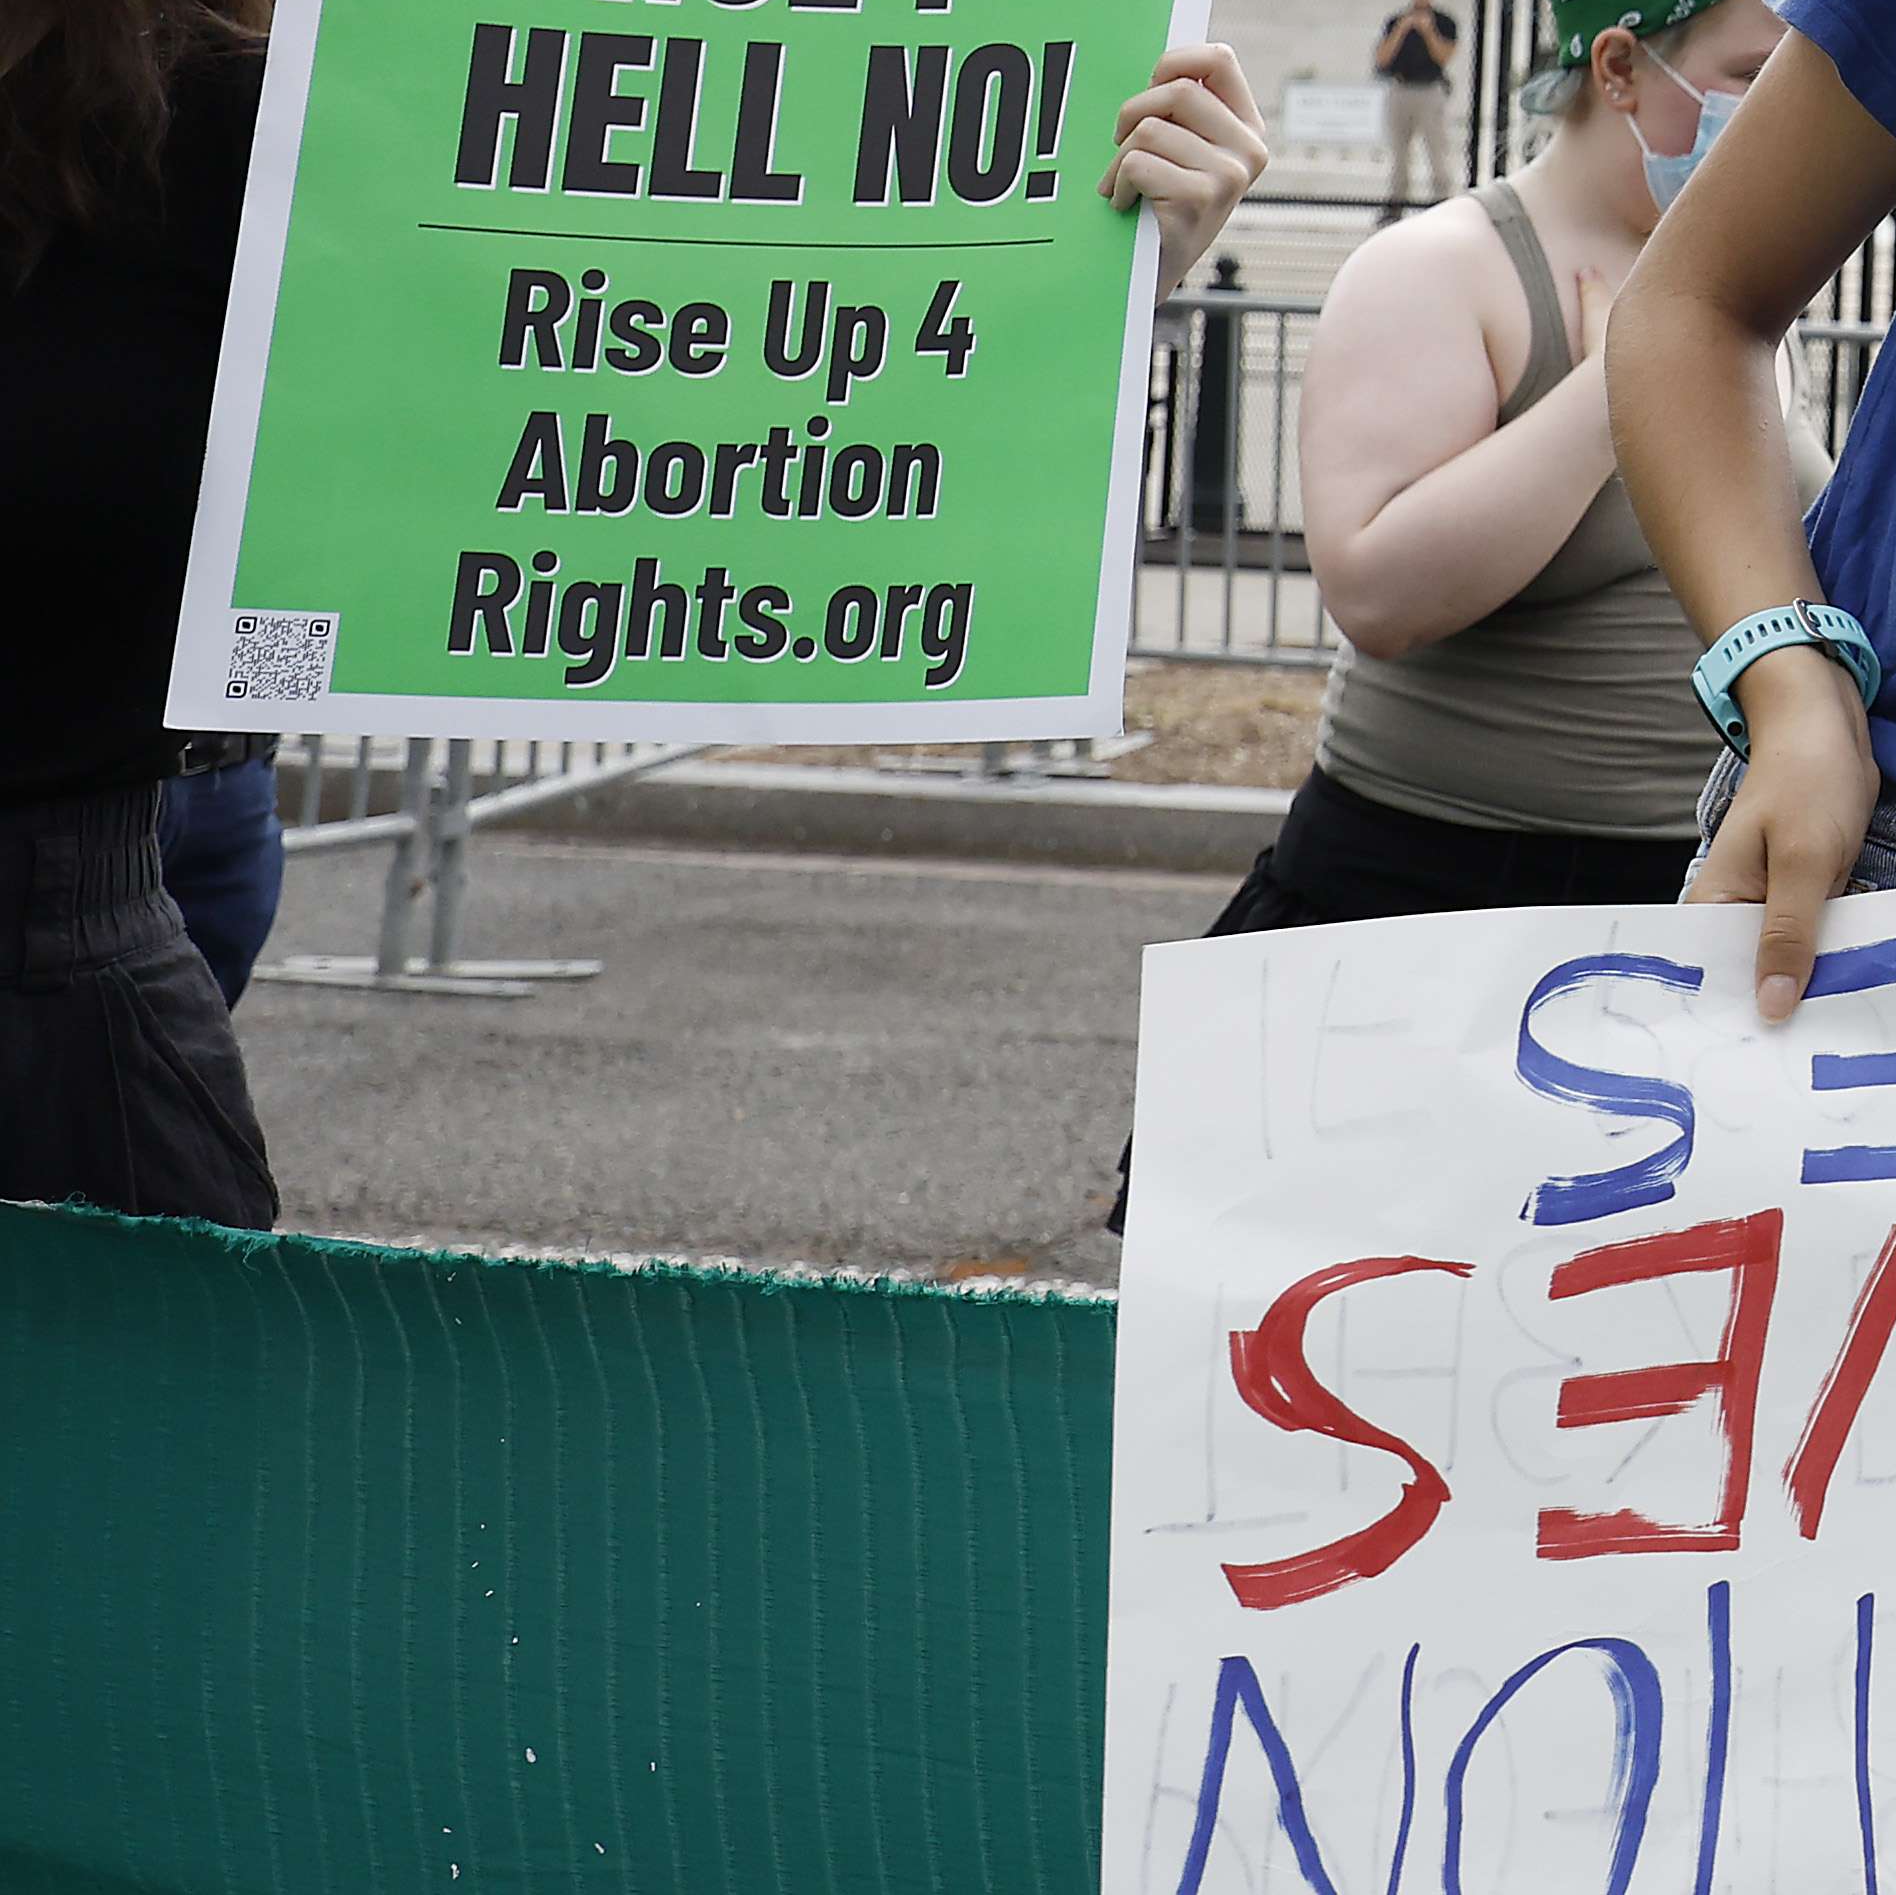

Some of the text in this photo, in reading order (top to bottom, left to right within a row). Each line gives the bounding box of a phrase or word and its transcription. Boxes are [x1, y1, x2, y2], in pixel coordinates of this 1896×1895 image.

[453, 22, 1077, 208] HELL NO!
[498, 268, 977, 404] Rise Up 4
[495, 411, 943, 520] Abortion
[446, 550, 977, 689] Rights.org
